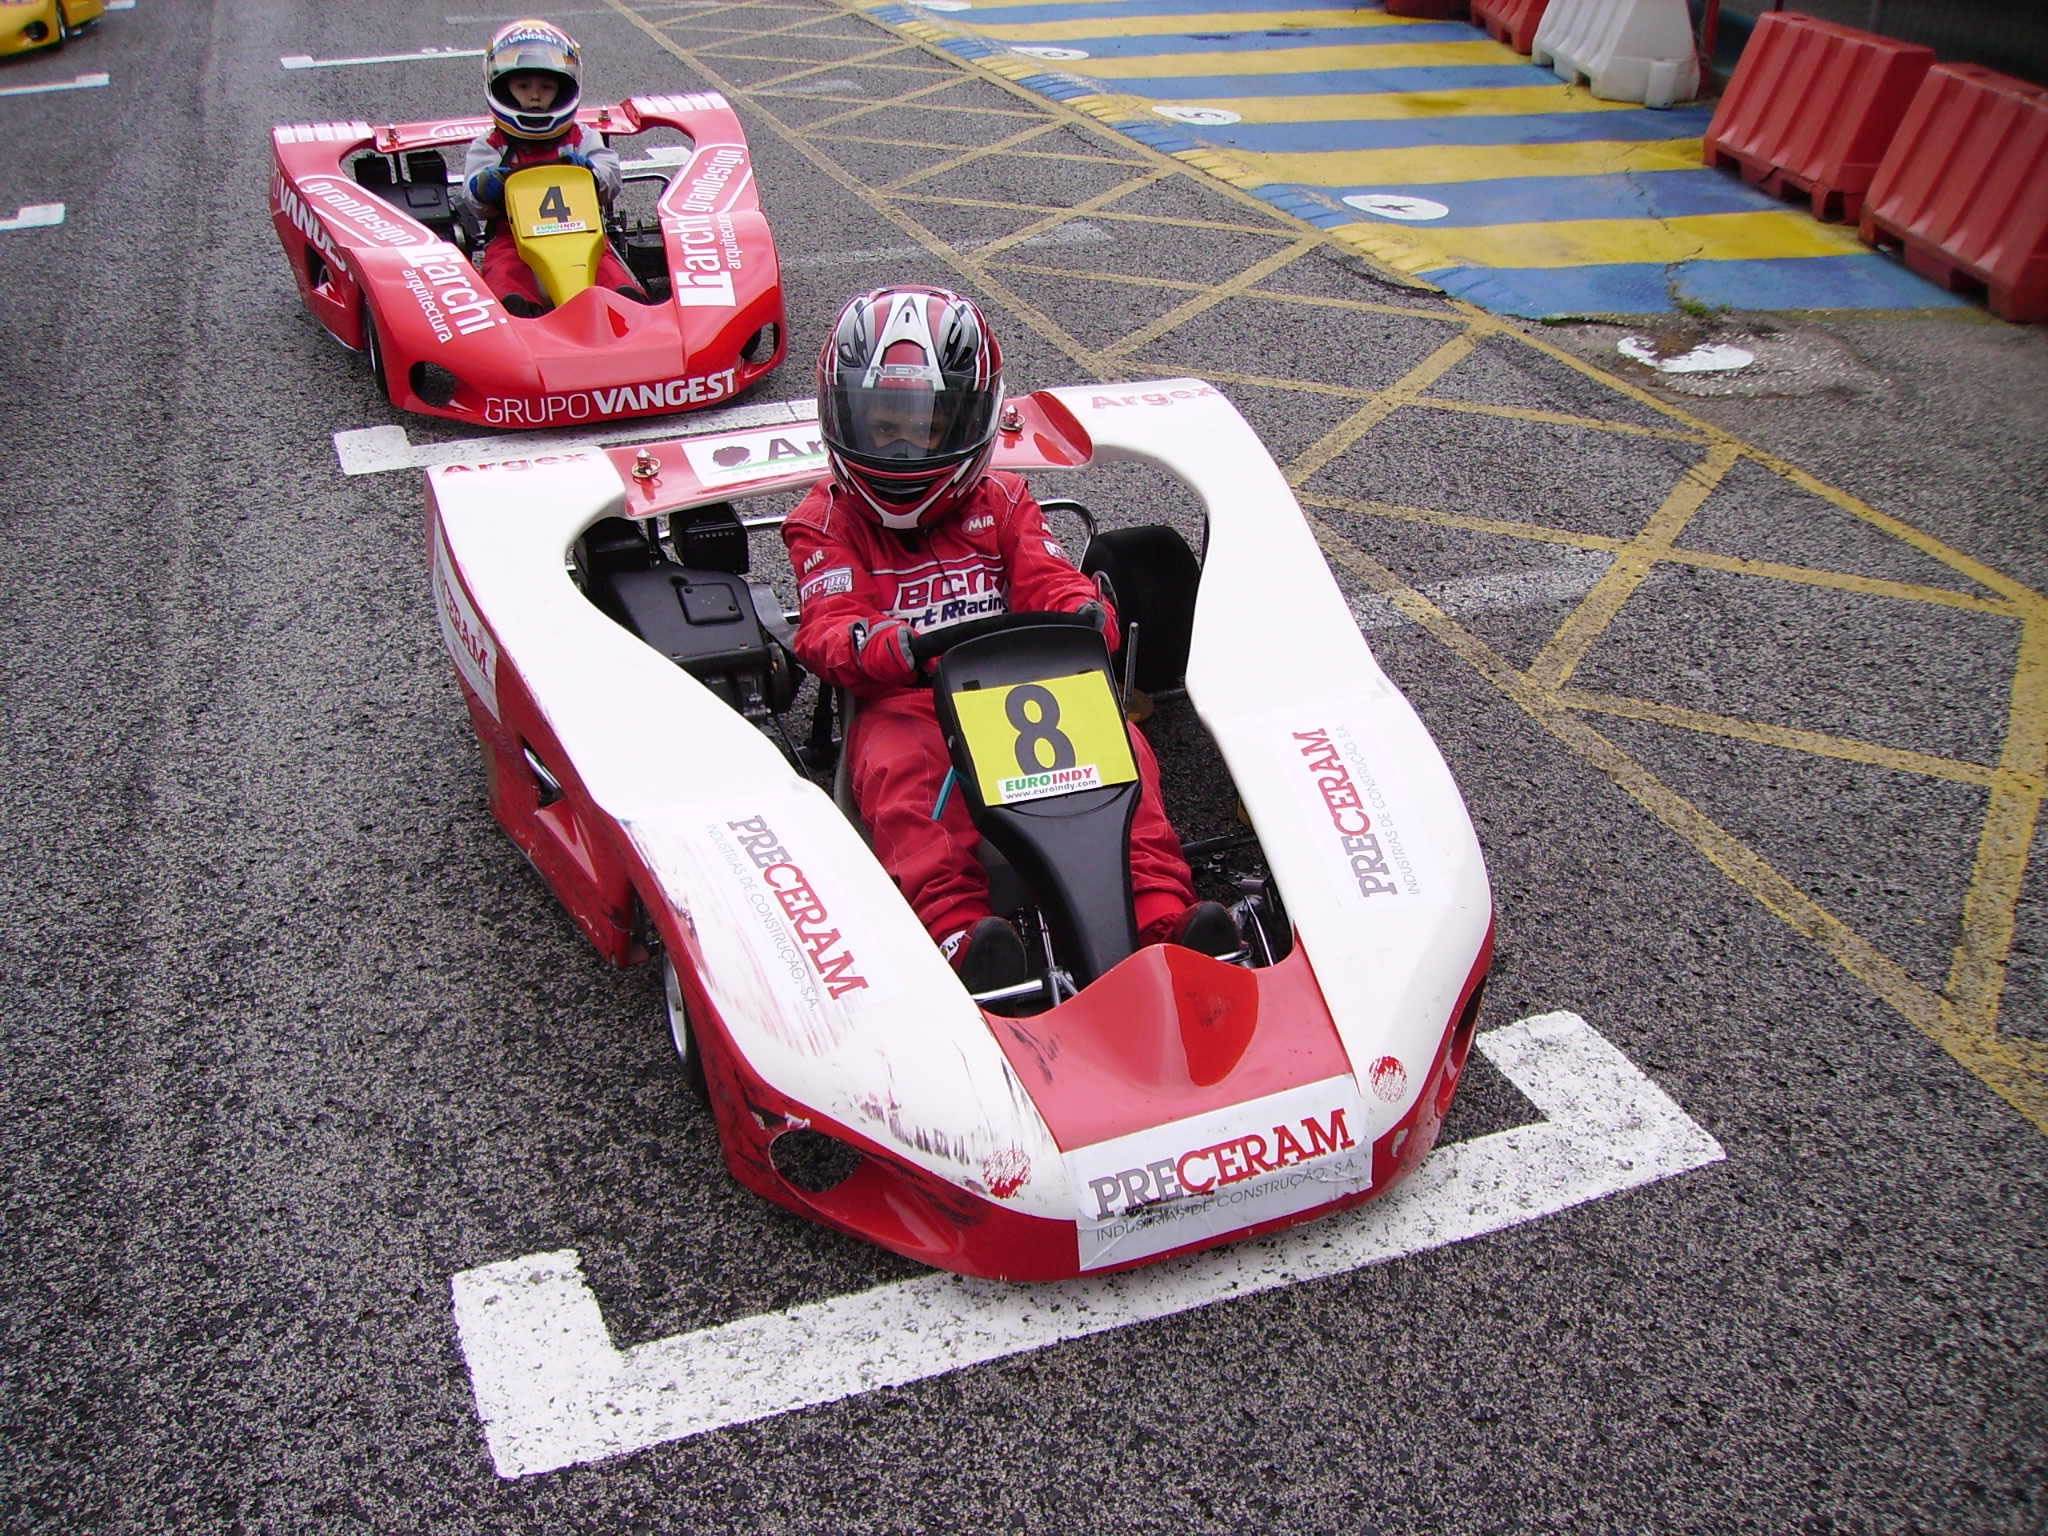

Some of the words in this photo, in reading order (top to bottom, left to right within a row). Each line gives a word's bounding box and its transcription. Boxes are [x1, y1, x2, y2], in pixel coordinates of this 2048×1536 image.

[539, 186, 571, 223] 4
[402, 269, 454, 344] arquitectura
[1092, 387, 1220, 410] Argex
[443, 453, 590, 476] Argex
[768, 438, 823, 461] Ar
[1004, 683, 1077, 777] 8
[1005, 766, 1093, 793] EUROINDY
[1006, 779, 1098, 800] www.euroindy.com
[1292, 728, 1399, 898] PRECERAM
[727, 814, 870, 1002] PRECERAM
[1087, 1107, 1357, 1223] PRECERAM
[1189, 1199, 1212, 1217] DE
